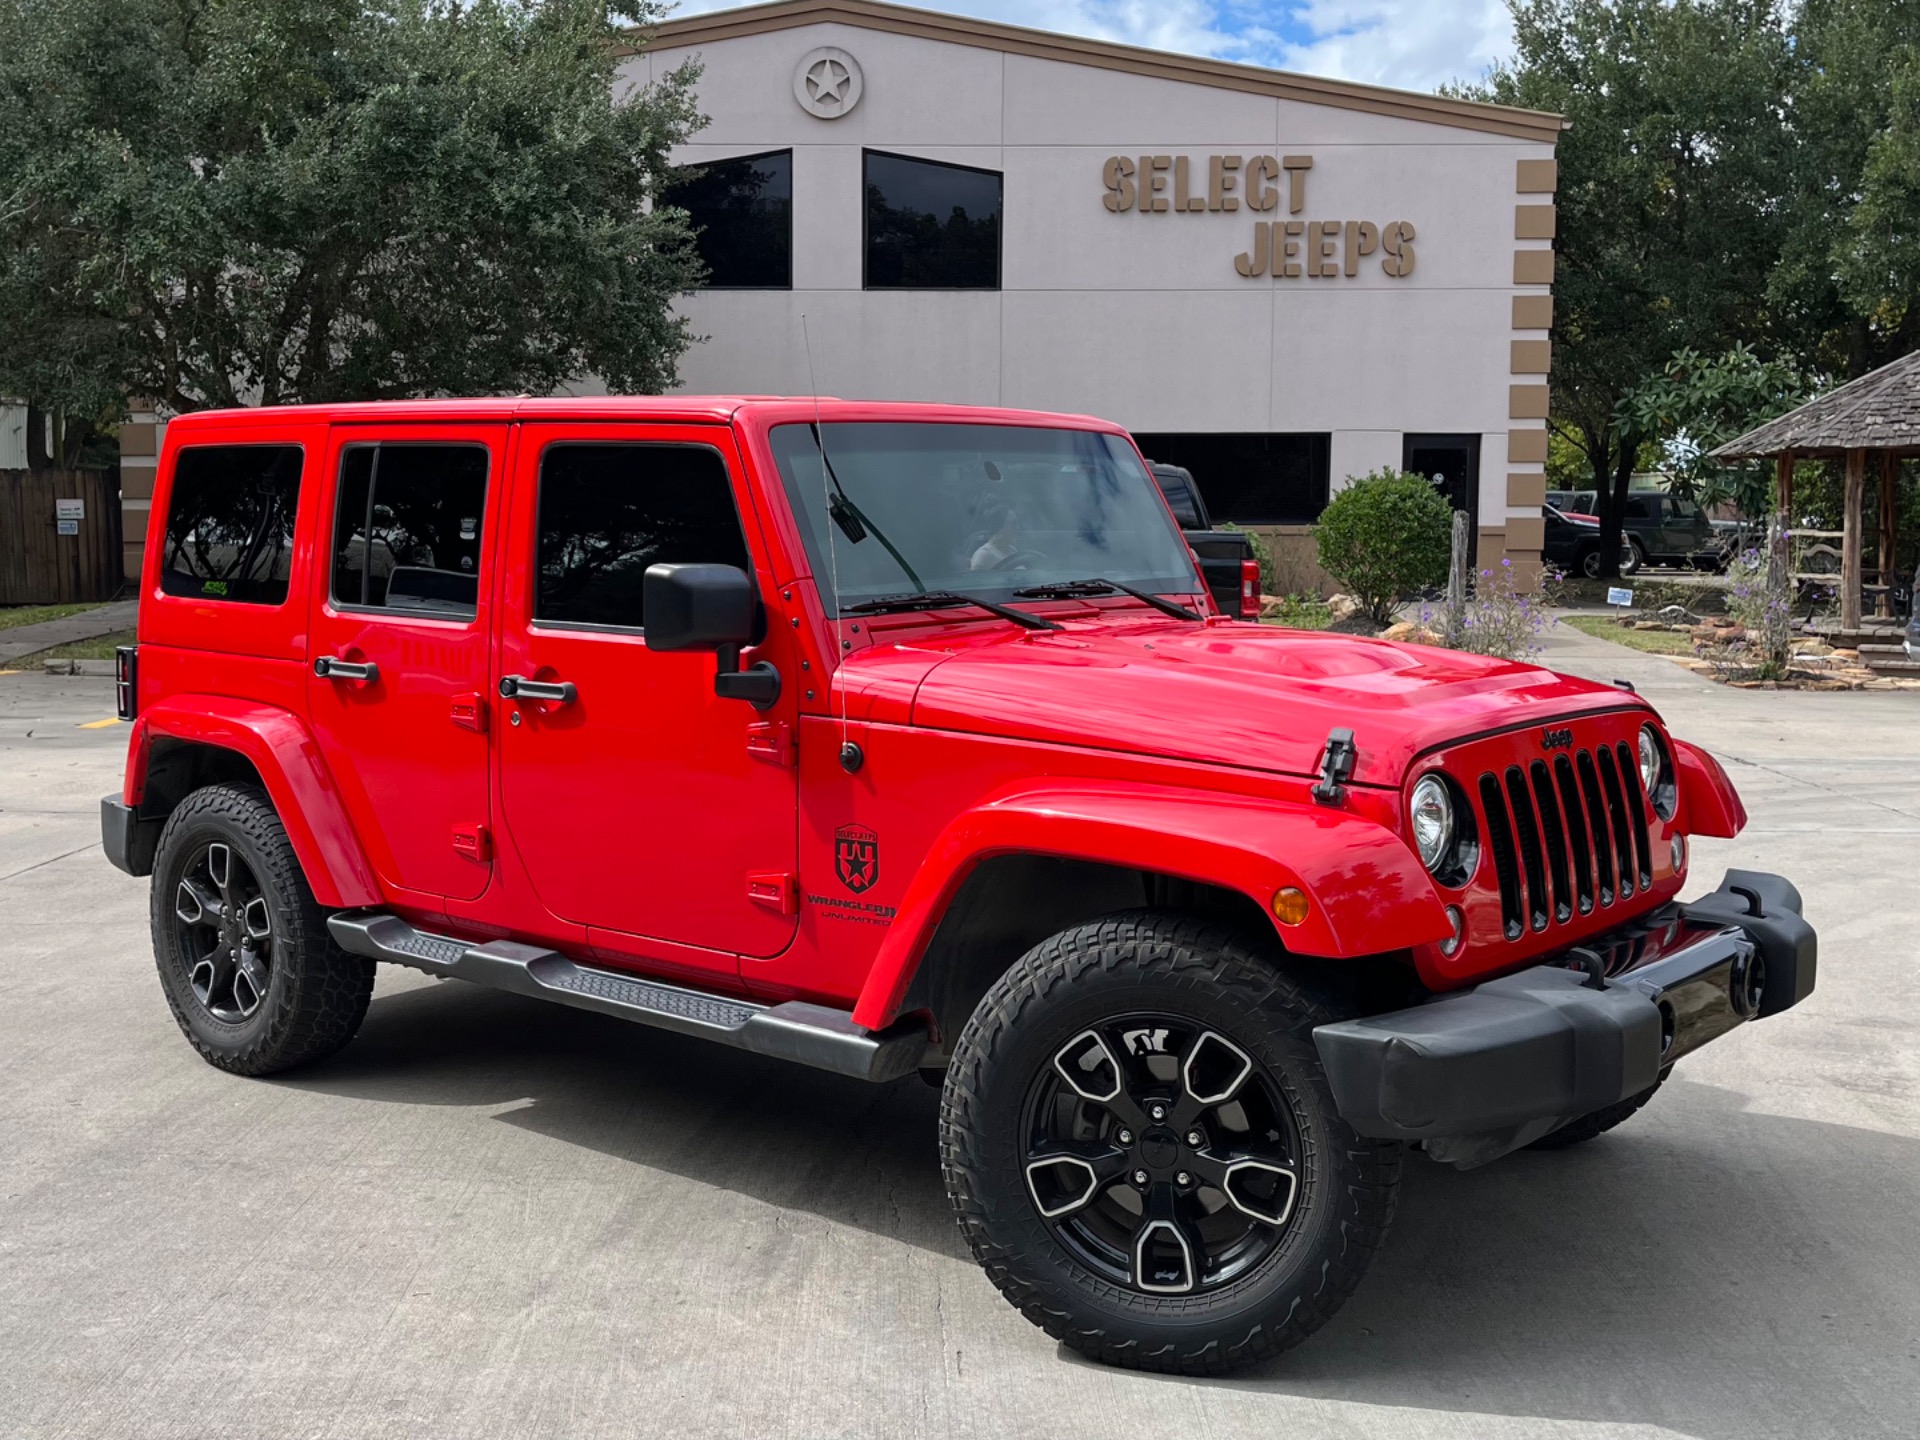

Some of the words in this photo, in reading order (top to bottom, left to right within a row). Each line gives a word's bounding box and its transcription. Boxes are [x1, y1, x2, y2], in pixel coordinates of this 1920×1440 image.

[1102, 155, 1313, 213] SELECT
[1234, 220, 1416, 277] JEEPS
[1541, 727, 1573, 751] Jeep
[807, 895, 883, 914] WRANGLER
[821, 911, 892, 926] UNLIMITED
